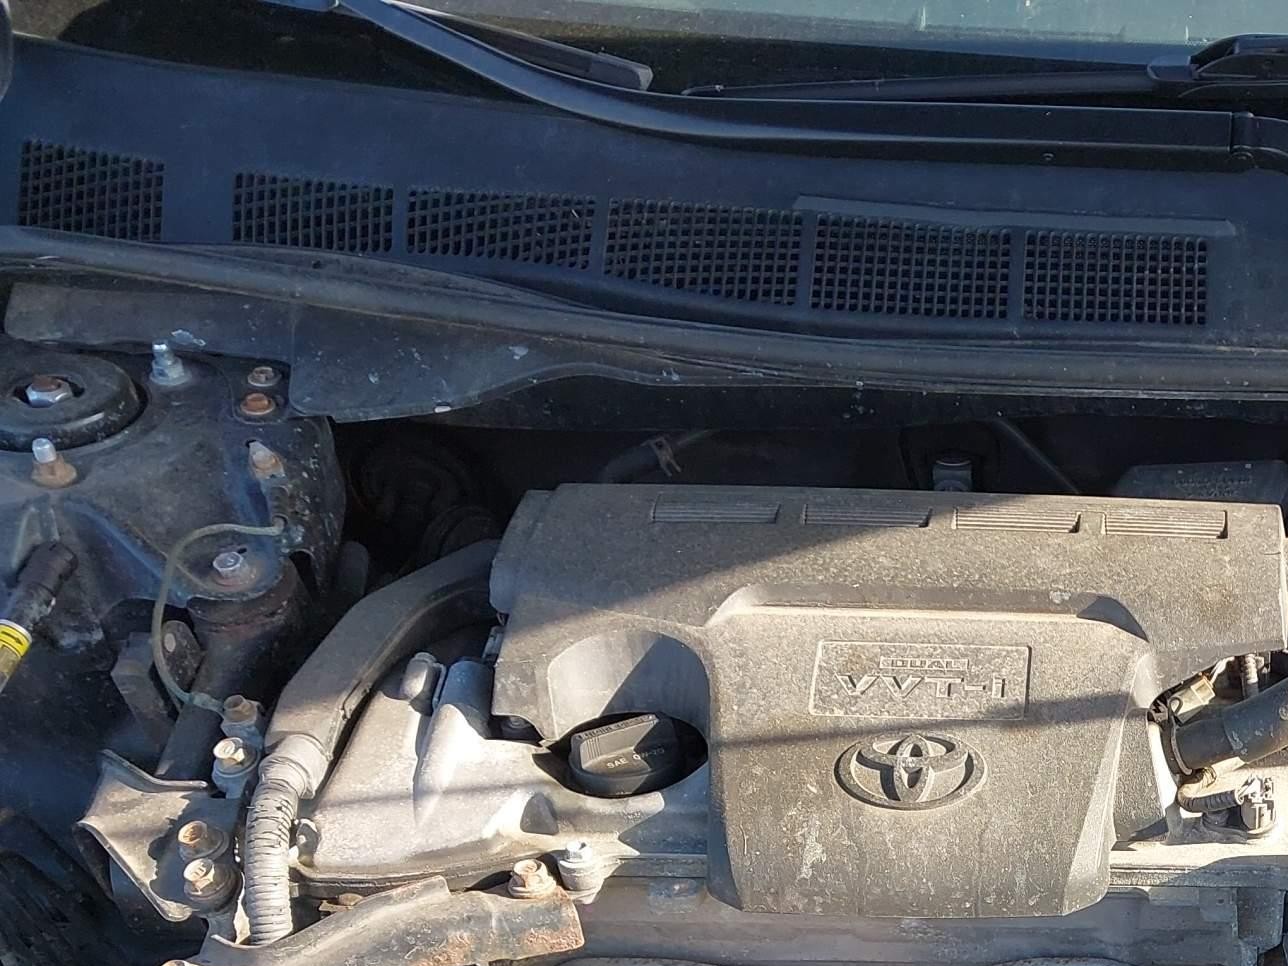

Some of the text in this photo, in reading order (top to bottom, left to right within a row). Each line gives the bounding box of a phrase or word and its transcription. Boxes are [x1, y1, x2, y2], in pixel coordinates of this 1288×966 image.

[891, 657, 963, 670] DUAL
[834, 671, 1006, 699] VVT-i
[606, 757, 630, 770] SAE
